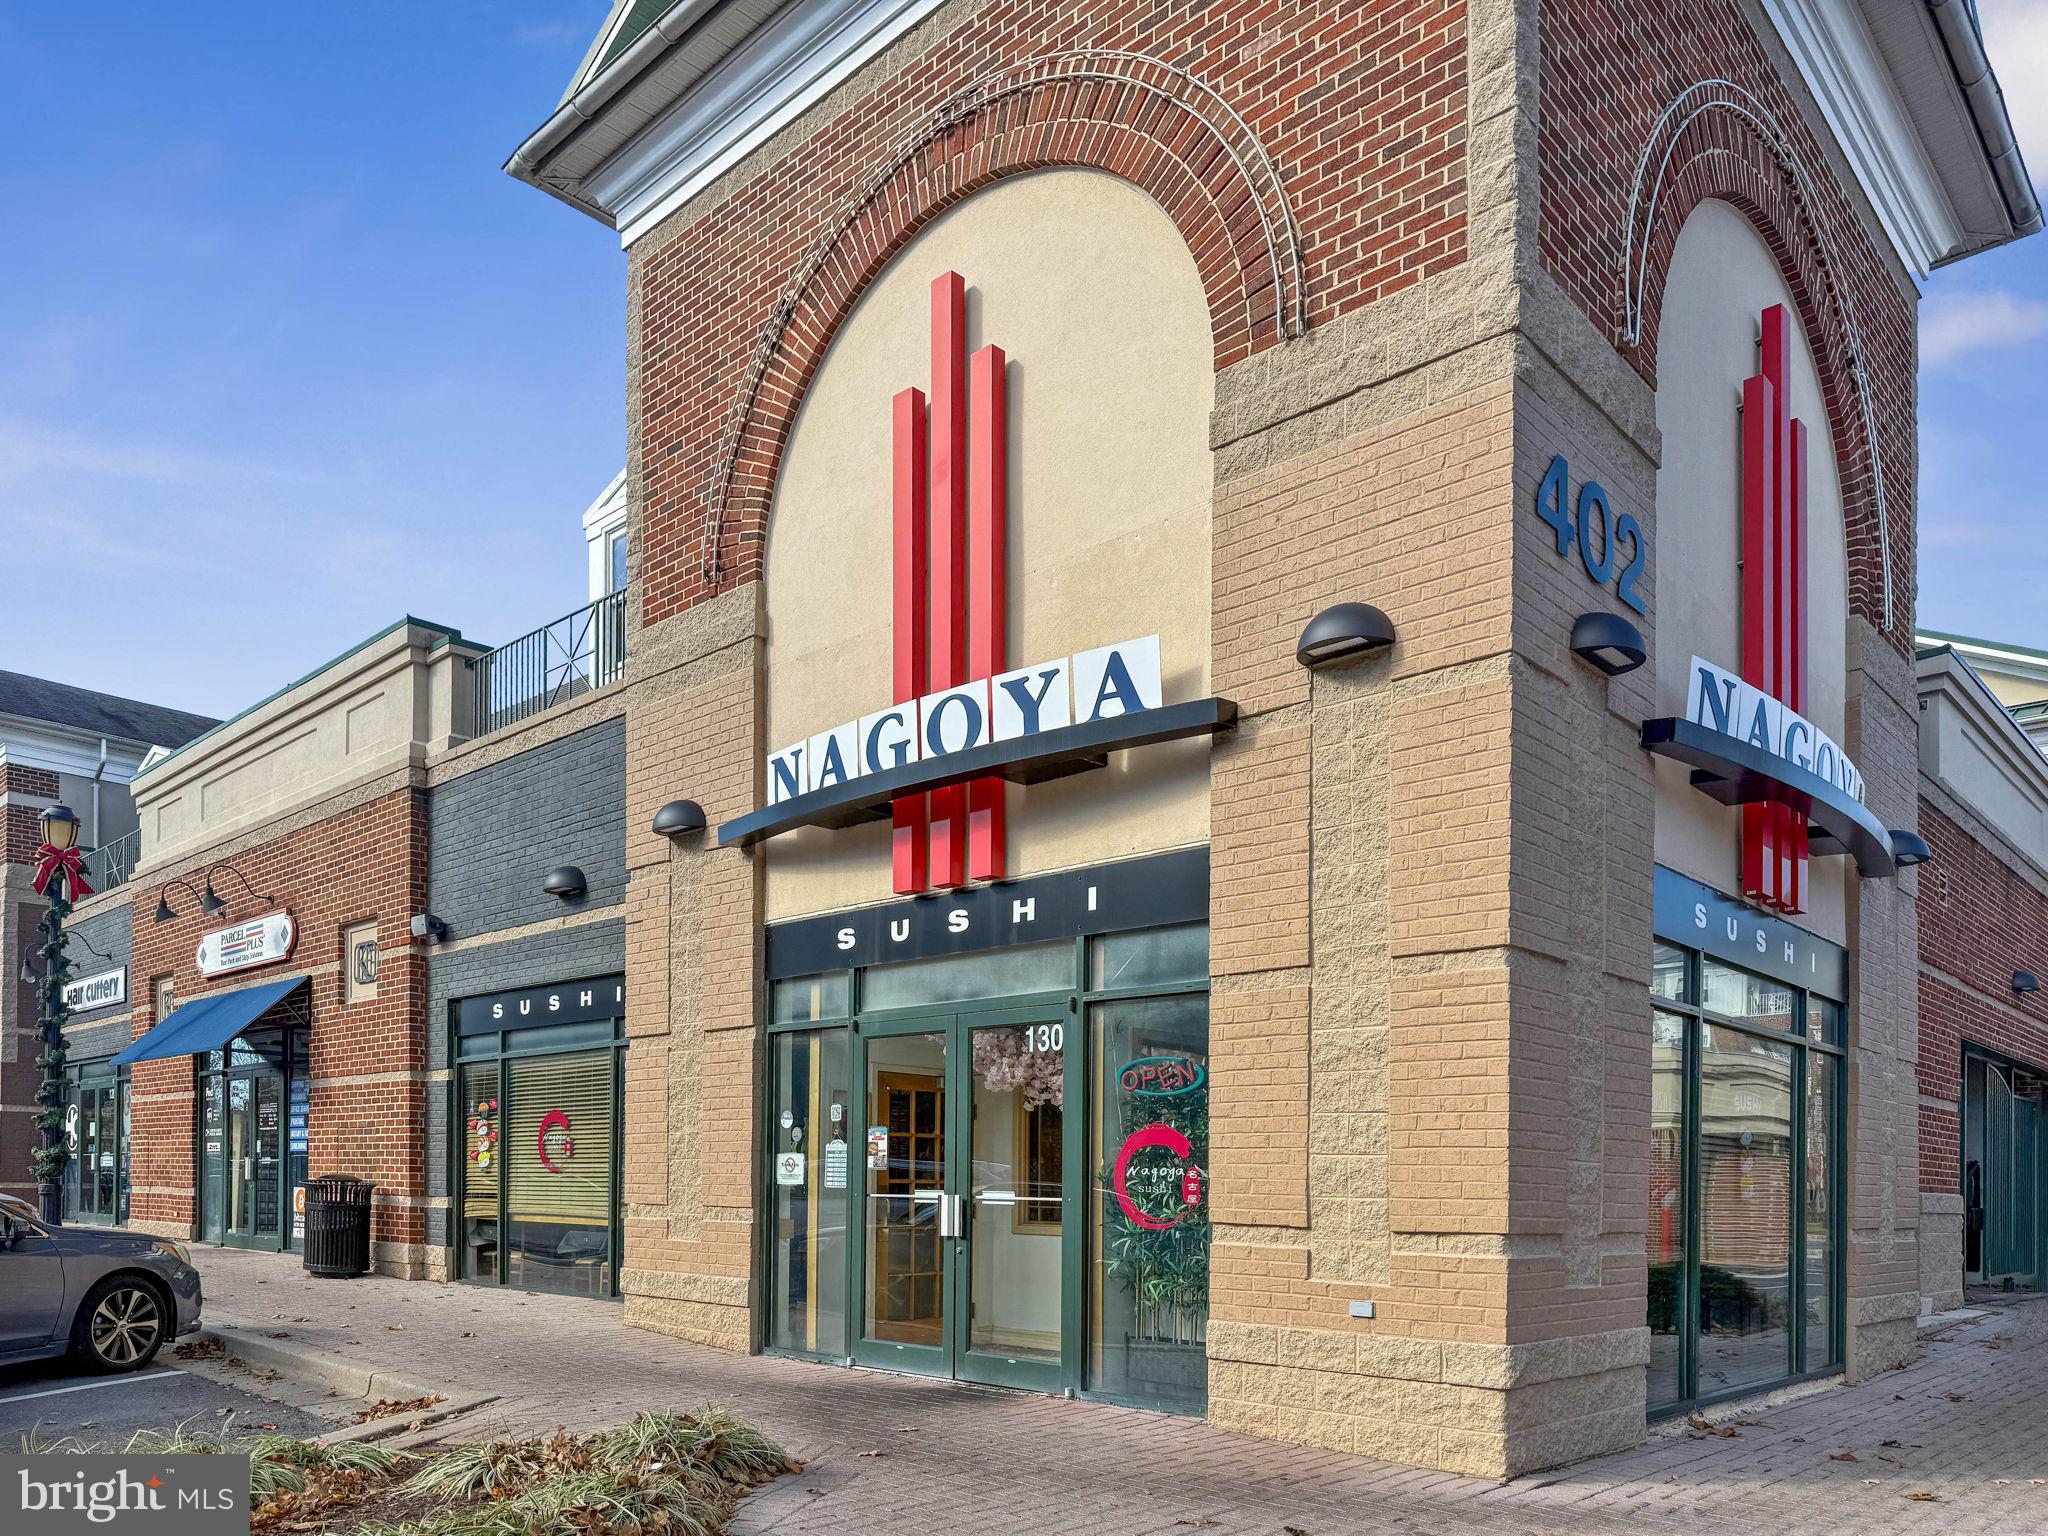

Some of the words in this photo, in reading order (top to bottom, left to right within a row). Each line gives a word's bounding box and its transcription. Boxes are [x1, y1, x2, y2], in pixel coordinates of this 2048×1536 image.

[1537, 454, 1647, 617] 402
[771, 651, 1151, 805] NAGOYA
[837, 886, 1098, 950] SUSHI
[221, 929, 245, 945] PARCEL
[246, 936, 264, 950] PLUS
[1694, 903, 1817, 973] SUSHI
[67, 985, 84, 1006] Hair
[492, 985, 622, 1019] SUSHI
[1025, 1023, 1064, 1053] 130
[1121, 1060, 1195, 1091] OPEN
[1126, 1165, 1186, 1183] Nagoya
[1138, 1183, 1173, 1193] sushi
